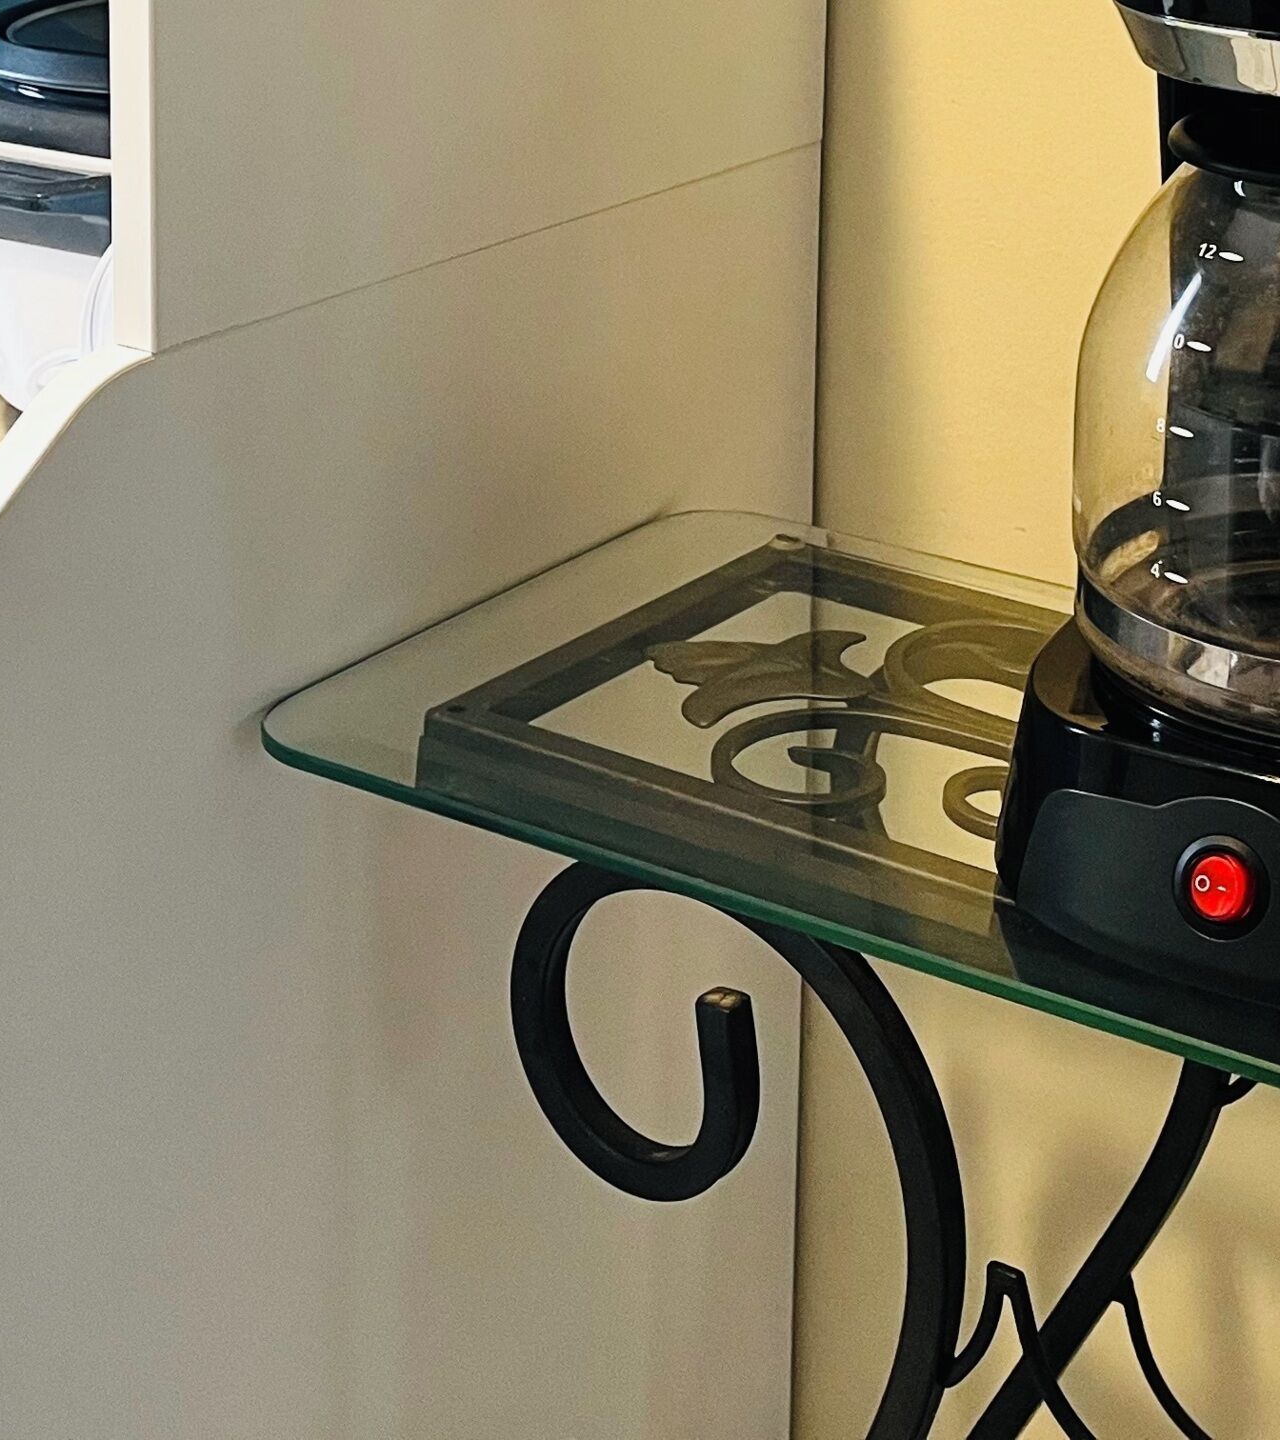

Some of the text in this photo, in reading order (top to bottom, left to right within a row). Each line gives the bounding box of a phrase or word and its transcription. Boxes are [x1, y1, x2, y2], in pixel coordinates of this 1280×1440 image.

[1198, 243, 1218, 260] 12
[1156, 417, 1166, 434] 8
[1152, 490, 1162, 507] 6
[1150, 561, 1163, 579] 4
